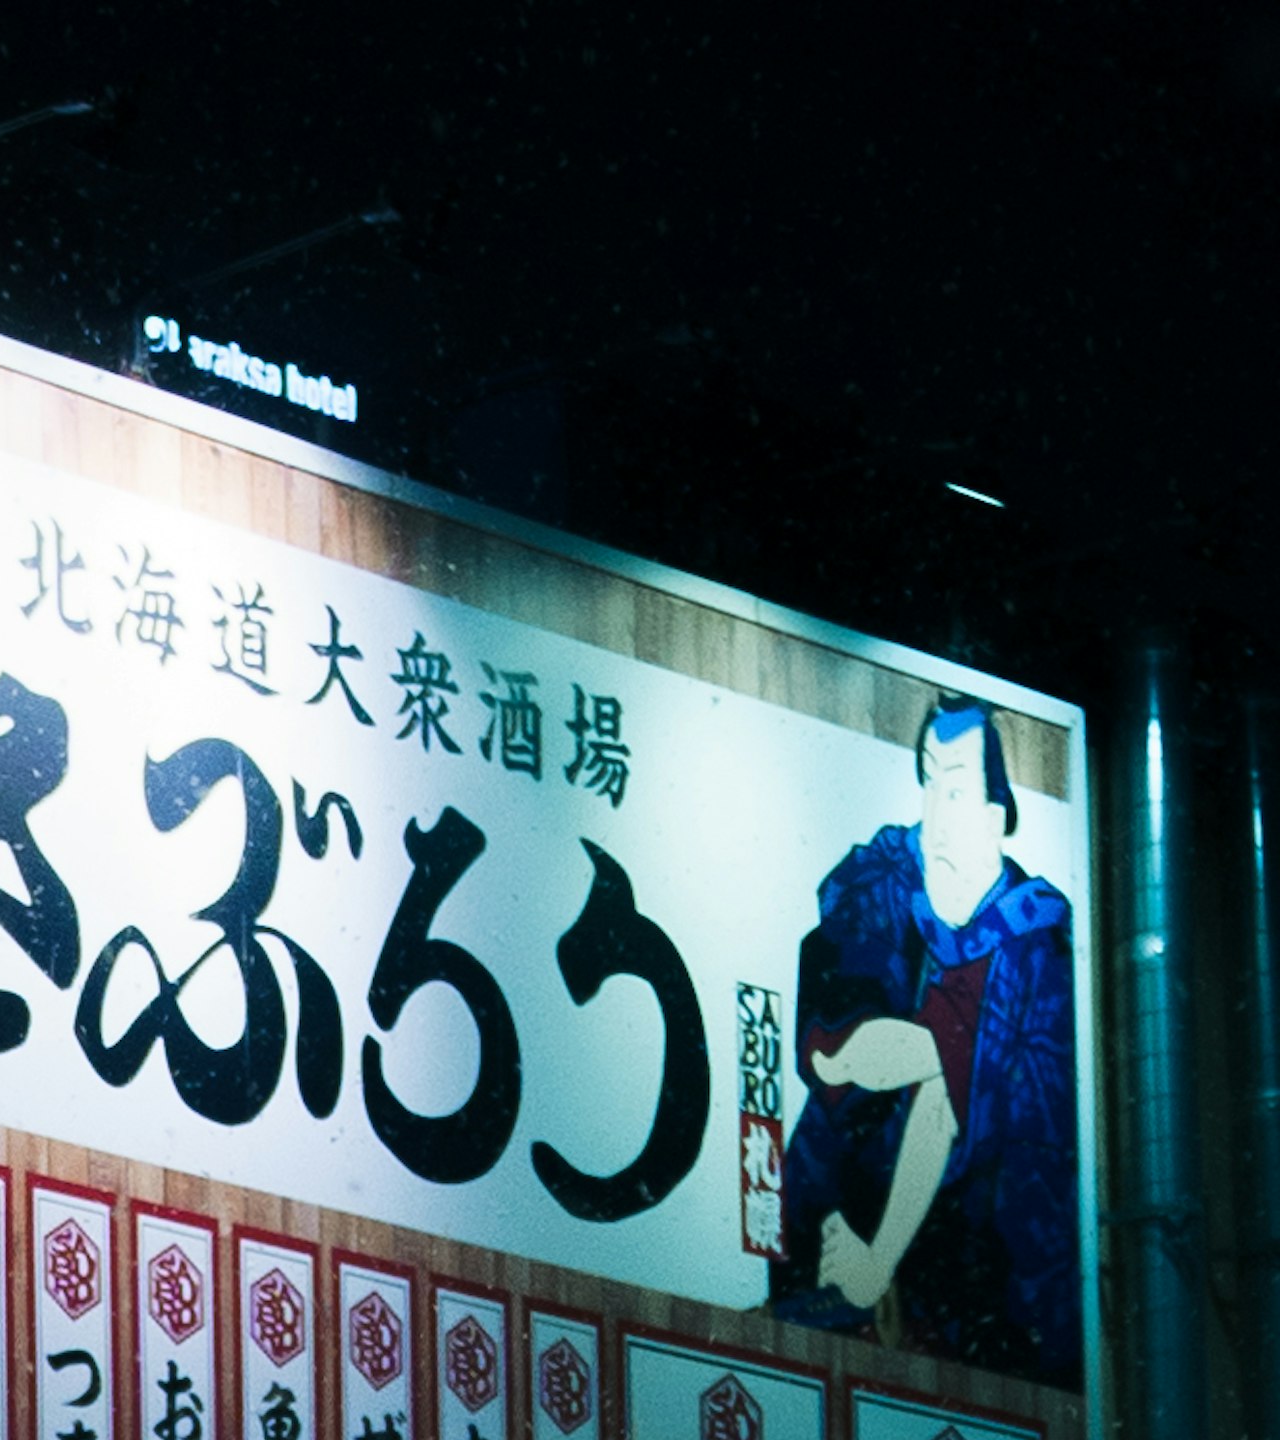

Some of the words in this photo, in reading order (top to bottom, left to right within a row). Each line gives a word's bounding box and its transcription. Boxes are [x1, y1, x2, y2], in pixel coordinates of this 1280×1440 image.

[285, 362, 357, 422] hotel
[17, 515, 633, 811] 北海道大衆酒場
